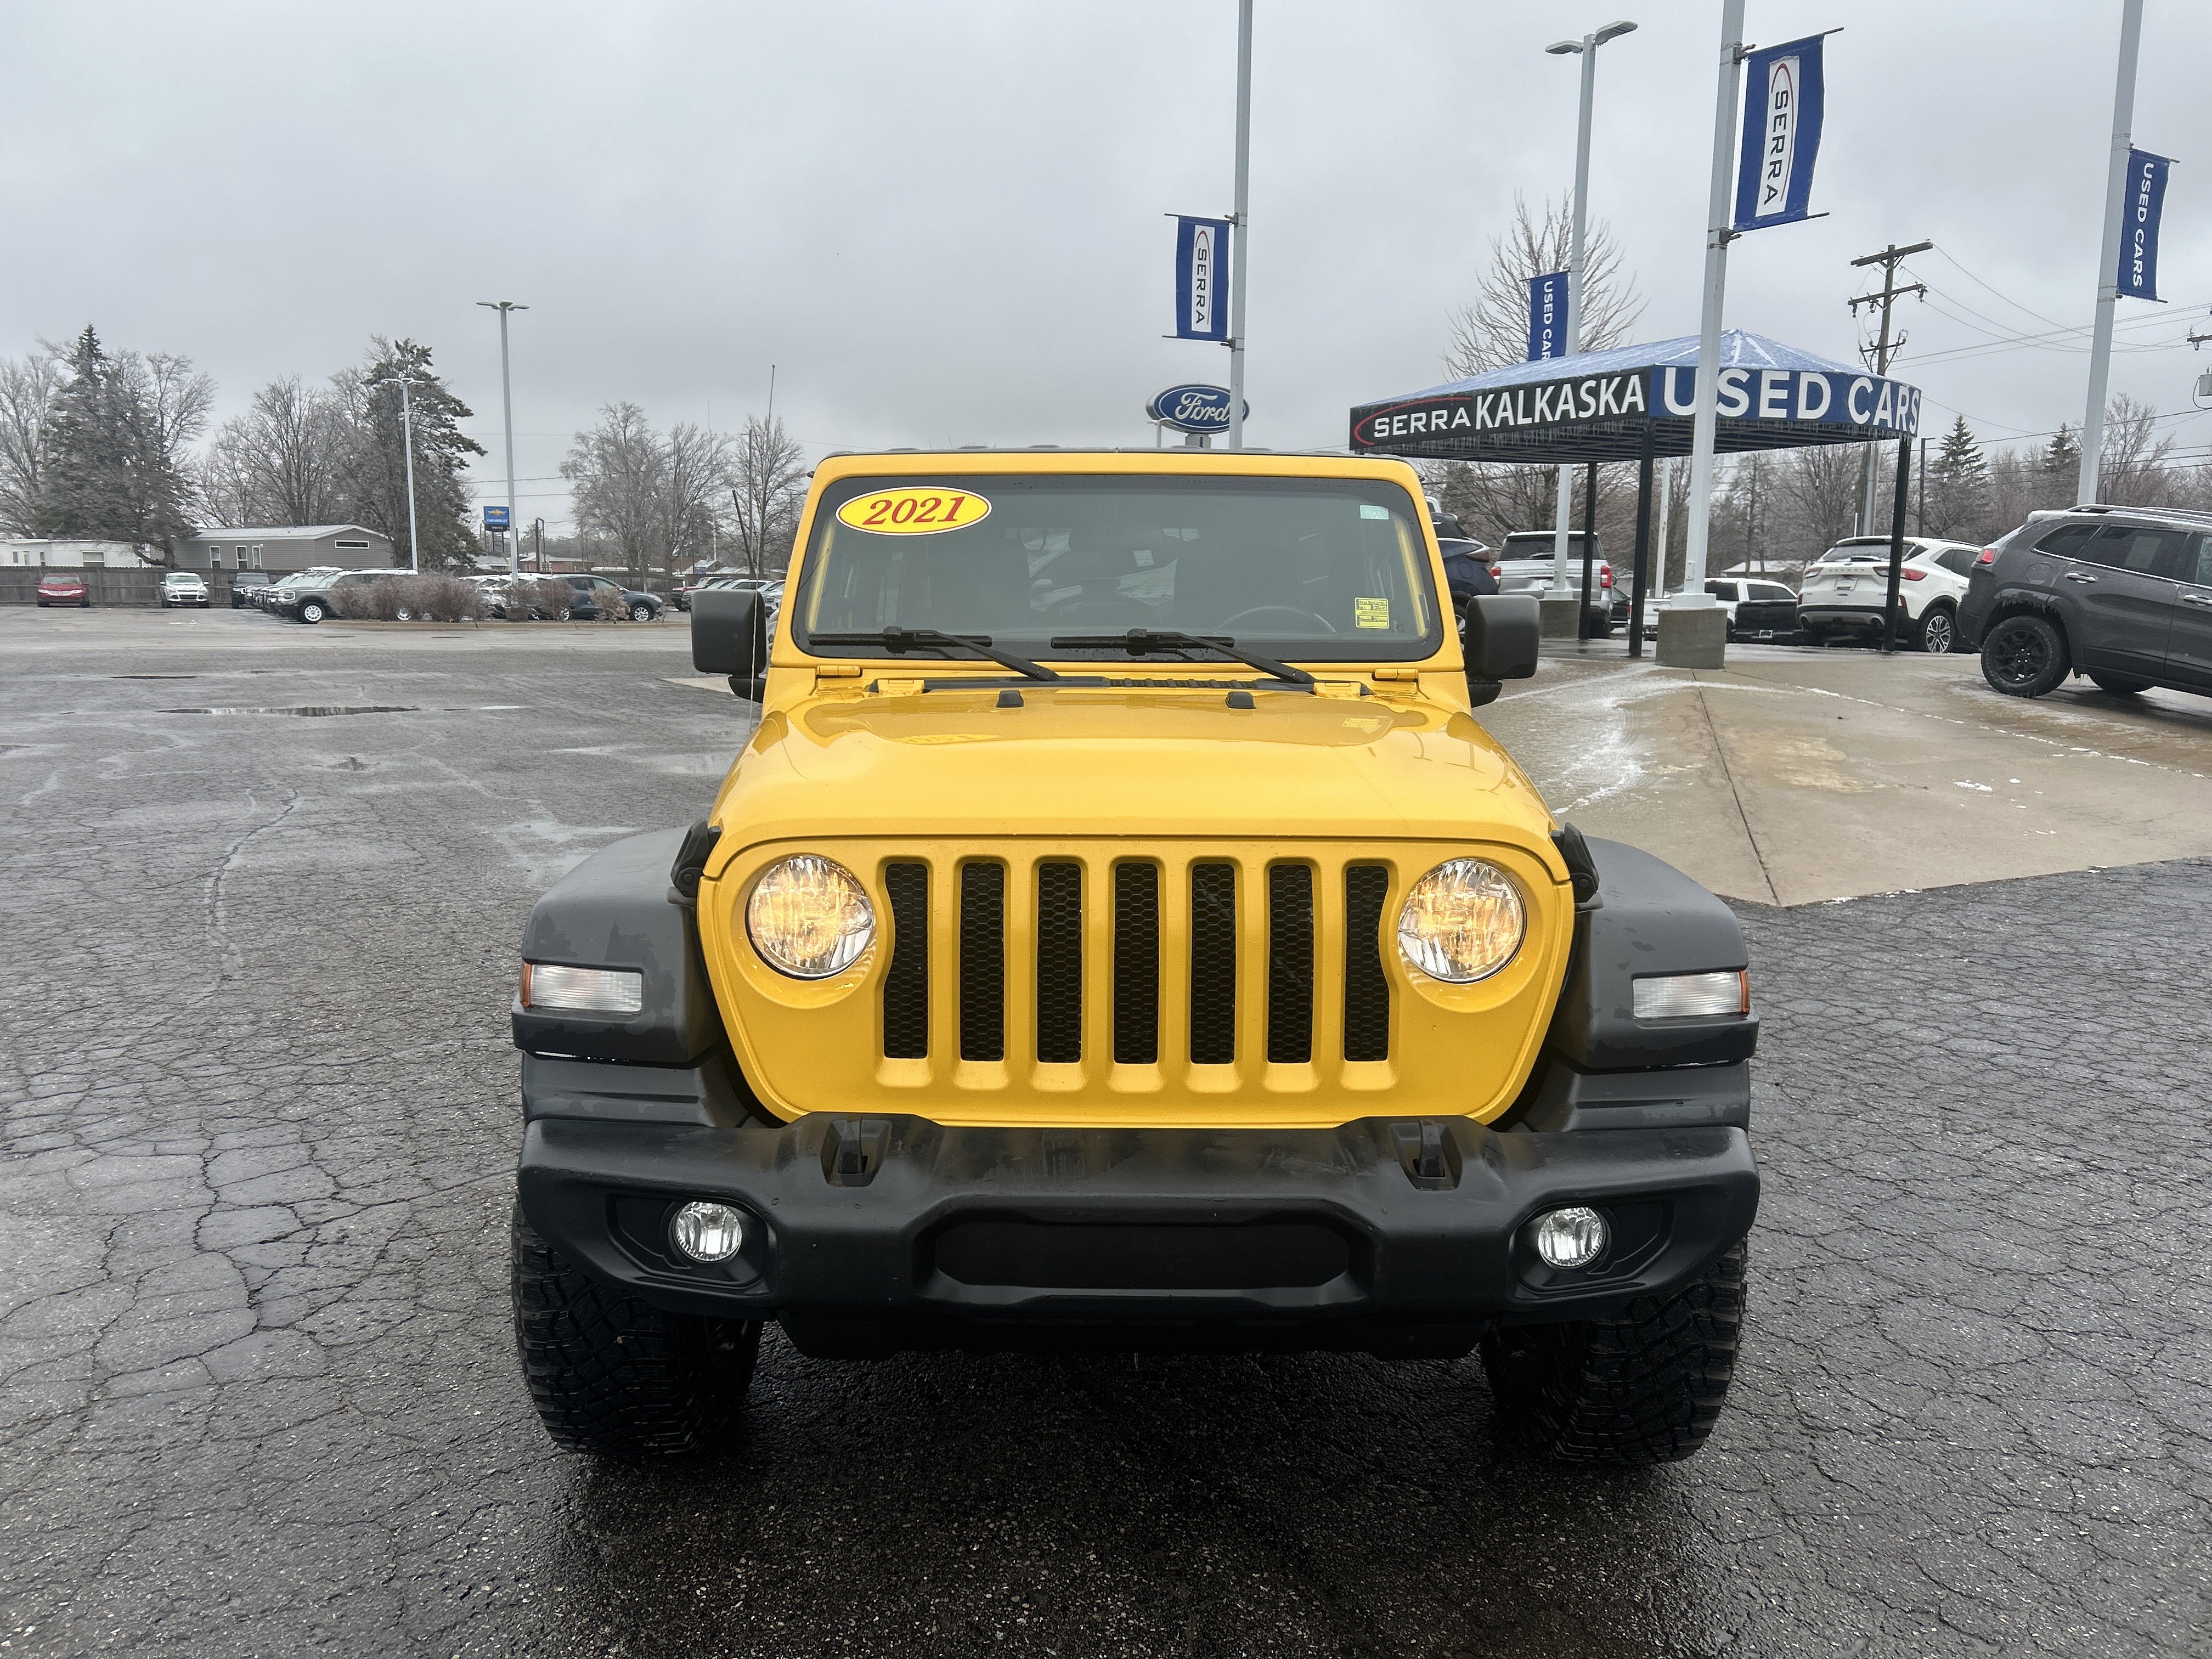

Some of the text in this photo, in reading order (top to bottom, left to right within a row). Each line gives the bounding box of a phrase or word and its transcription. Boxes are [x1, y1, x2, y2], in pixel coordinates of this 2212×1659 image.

[1763, 89, 1788, 205] SERRA
[2132, 162, 2154, 287] USED CARS
[1196, 248, 1207, 324] SERRA
[1541, 280, 1554, 360] USED CAR
[1175, 392, 1230, 422] Ford
[1374, 374, 1645, 438] SERRA KALKASKA
[1663, 367, 1921, 435] USED CARS
[862, 496, 966, 525] 2021
